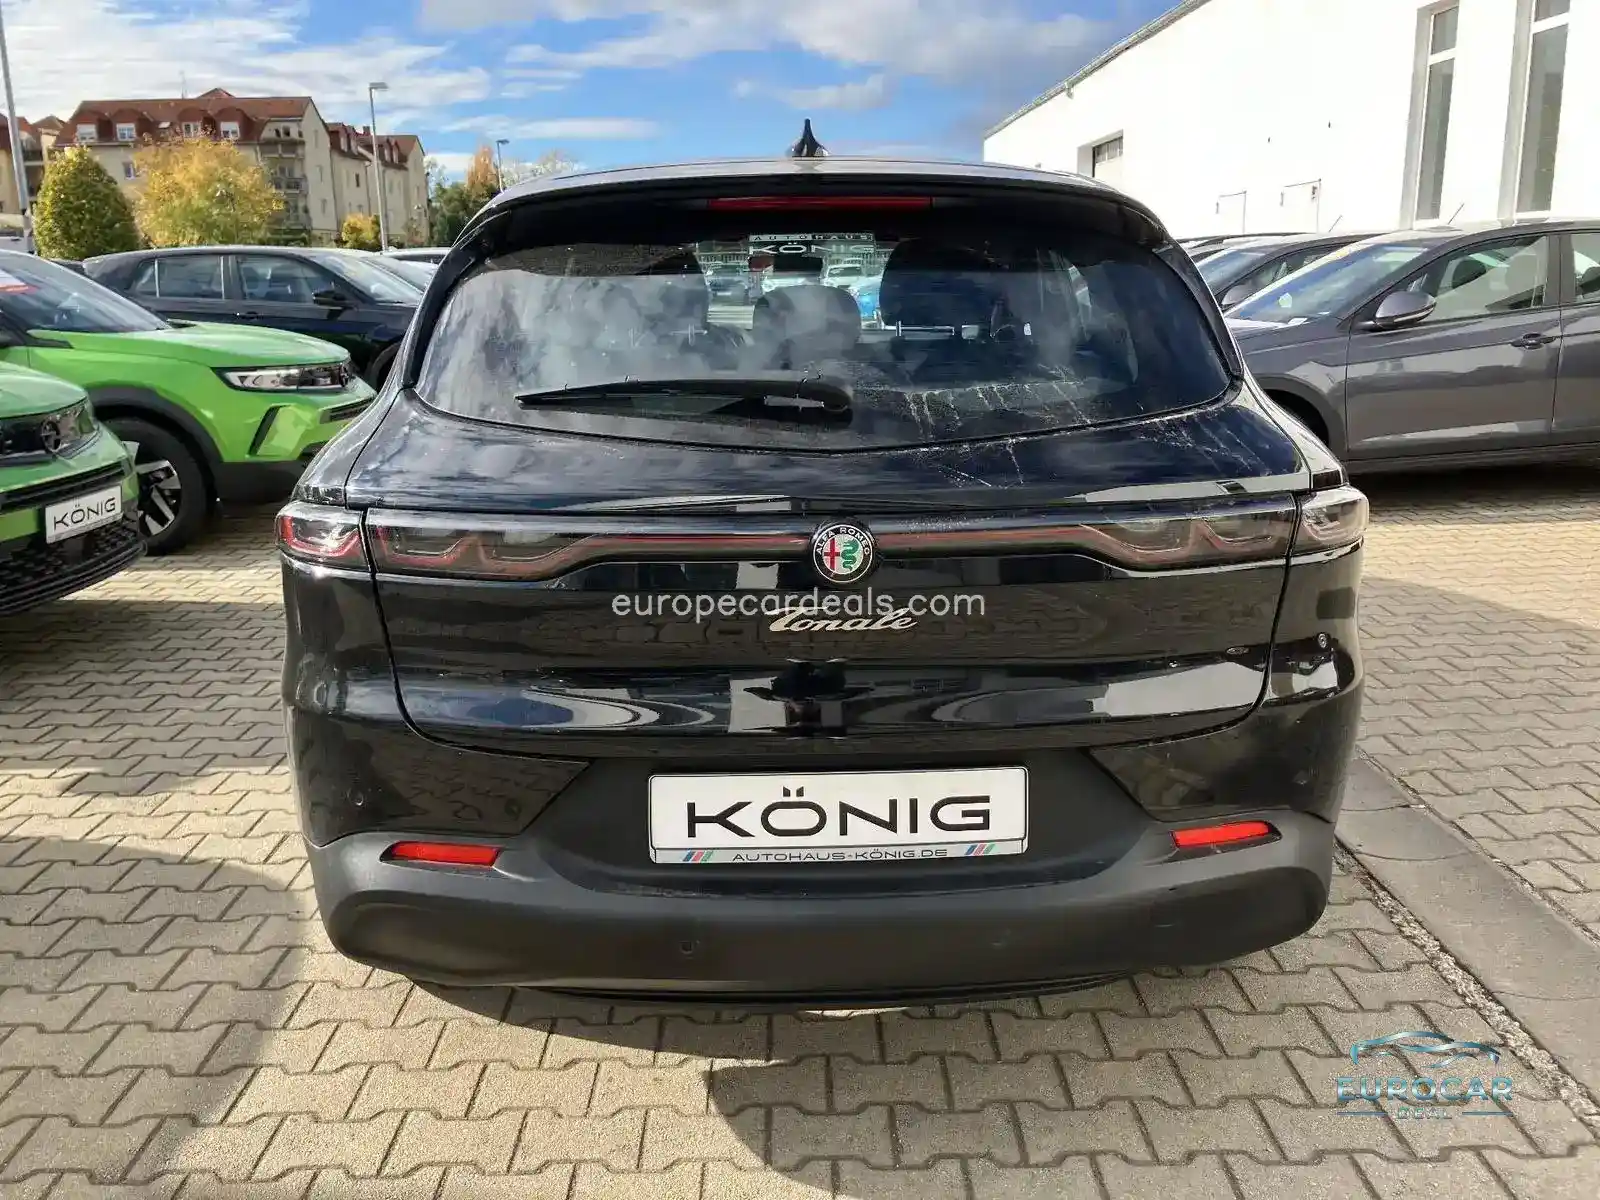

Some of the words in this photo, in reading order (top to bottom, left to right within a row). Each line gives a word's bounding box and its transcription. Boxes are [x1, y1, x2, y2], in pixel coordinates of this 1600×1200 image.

[748, 242, 875, 255] KÖNIG
[53, 497, 116, 531] KÖNIG
[816, 530, 836, 555] ALFA
[839, 527, 871, 556] ROMEO
[764, 606, 919, 632] Tonale
[686, 786, 991, 838] KÖNIG
[732, 848, 949, 862] AUTOHAUS-KÖNIG.DE
